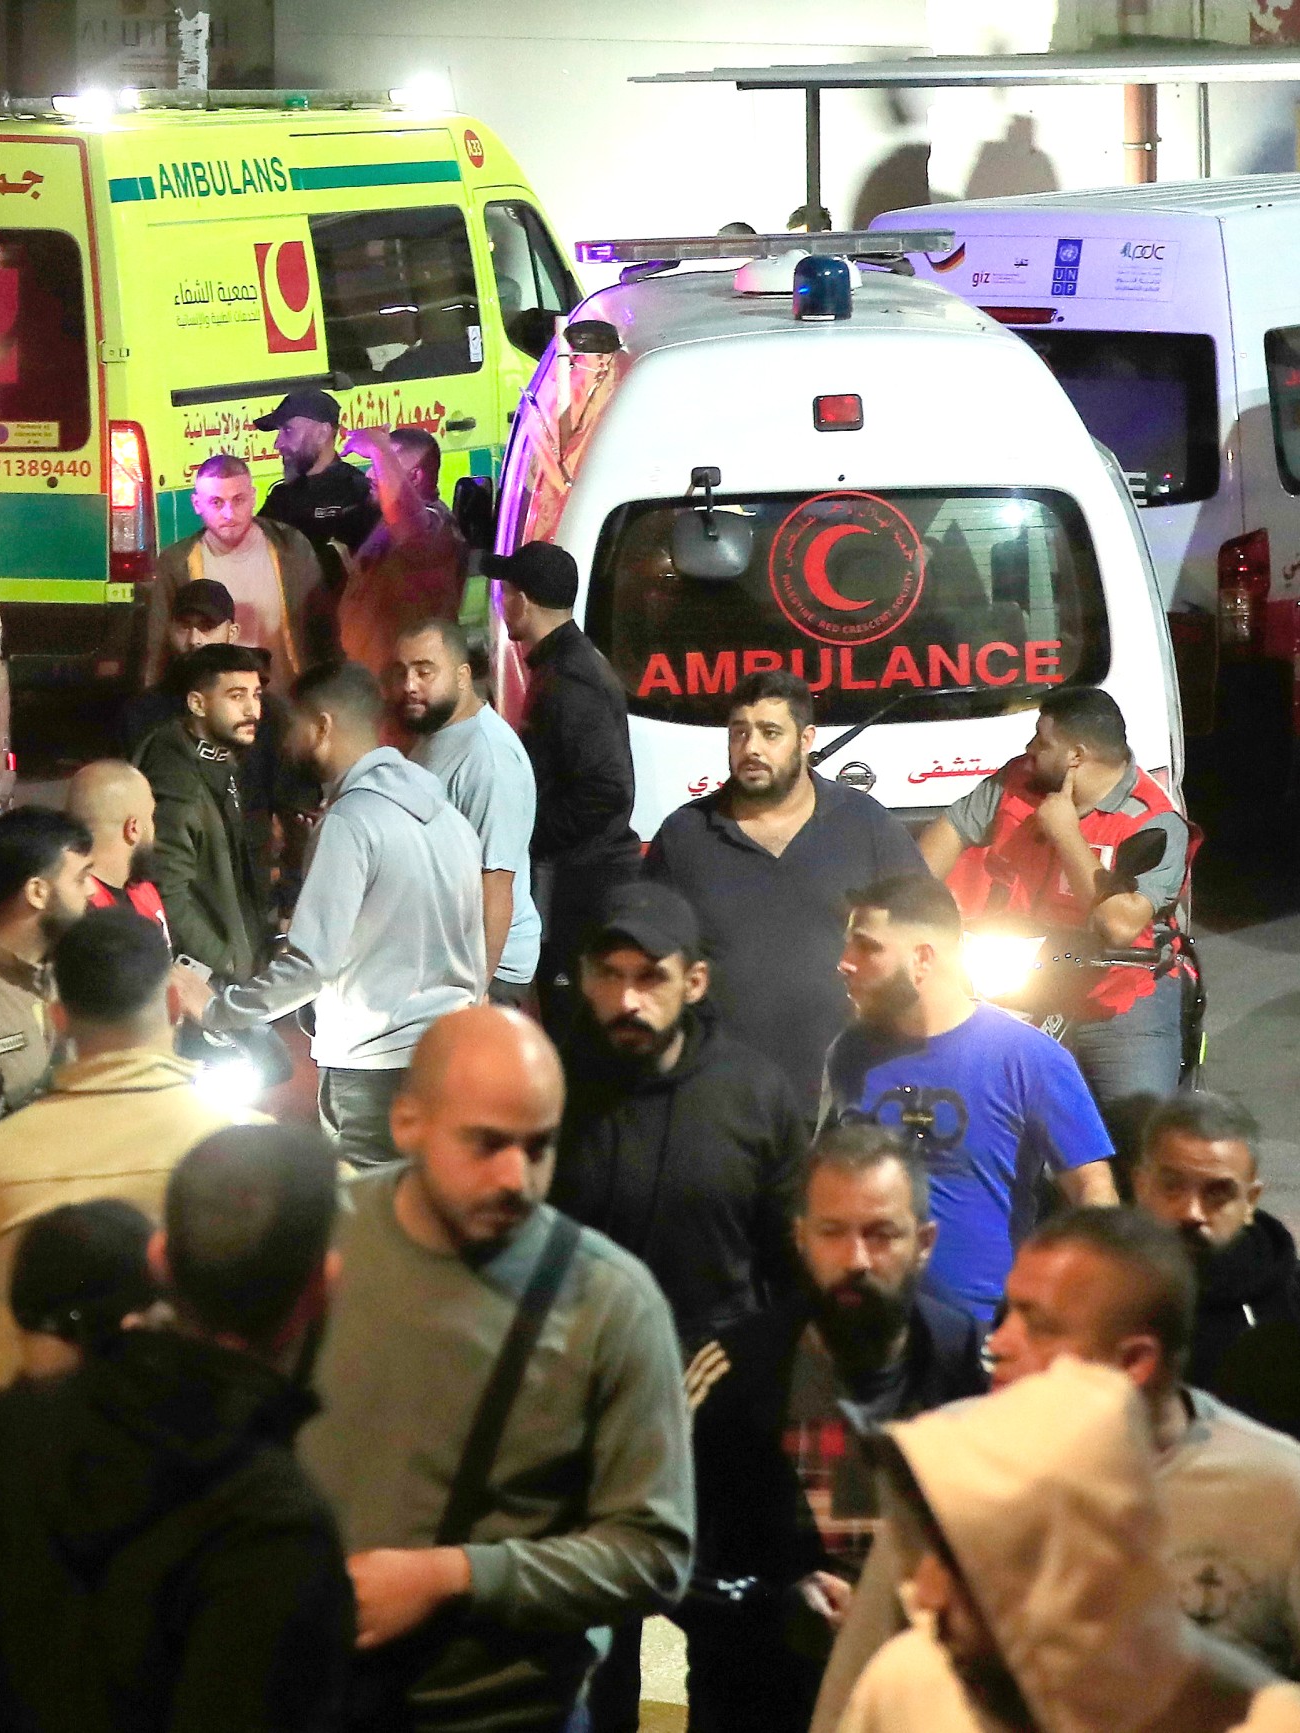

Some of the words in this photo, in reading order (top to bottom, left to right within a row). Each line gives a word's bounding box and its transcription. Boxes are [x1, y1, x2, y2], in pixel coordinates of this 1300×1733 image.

[159, 156, 287, 199] AMBULANS
[174, 279, 213, 306] الشفاء
[972, 270, 991, 288] giz
[217, 281, 258, 306] جمعية
[637, 641, 1065, 697] AMBULANCE
[907, 755, 1001, 785] ستشفى
